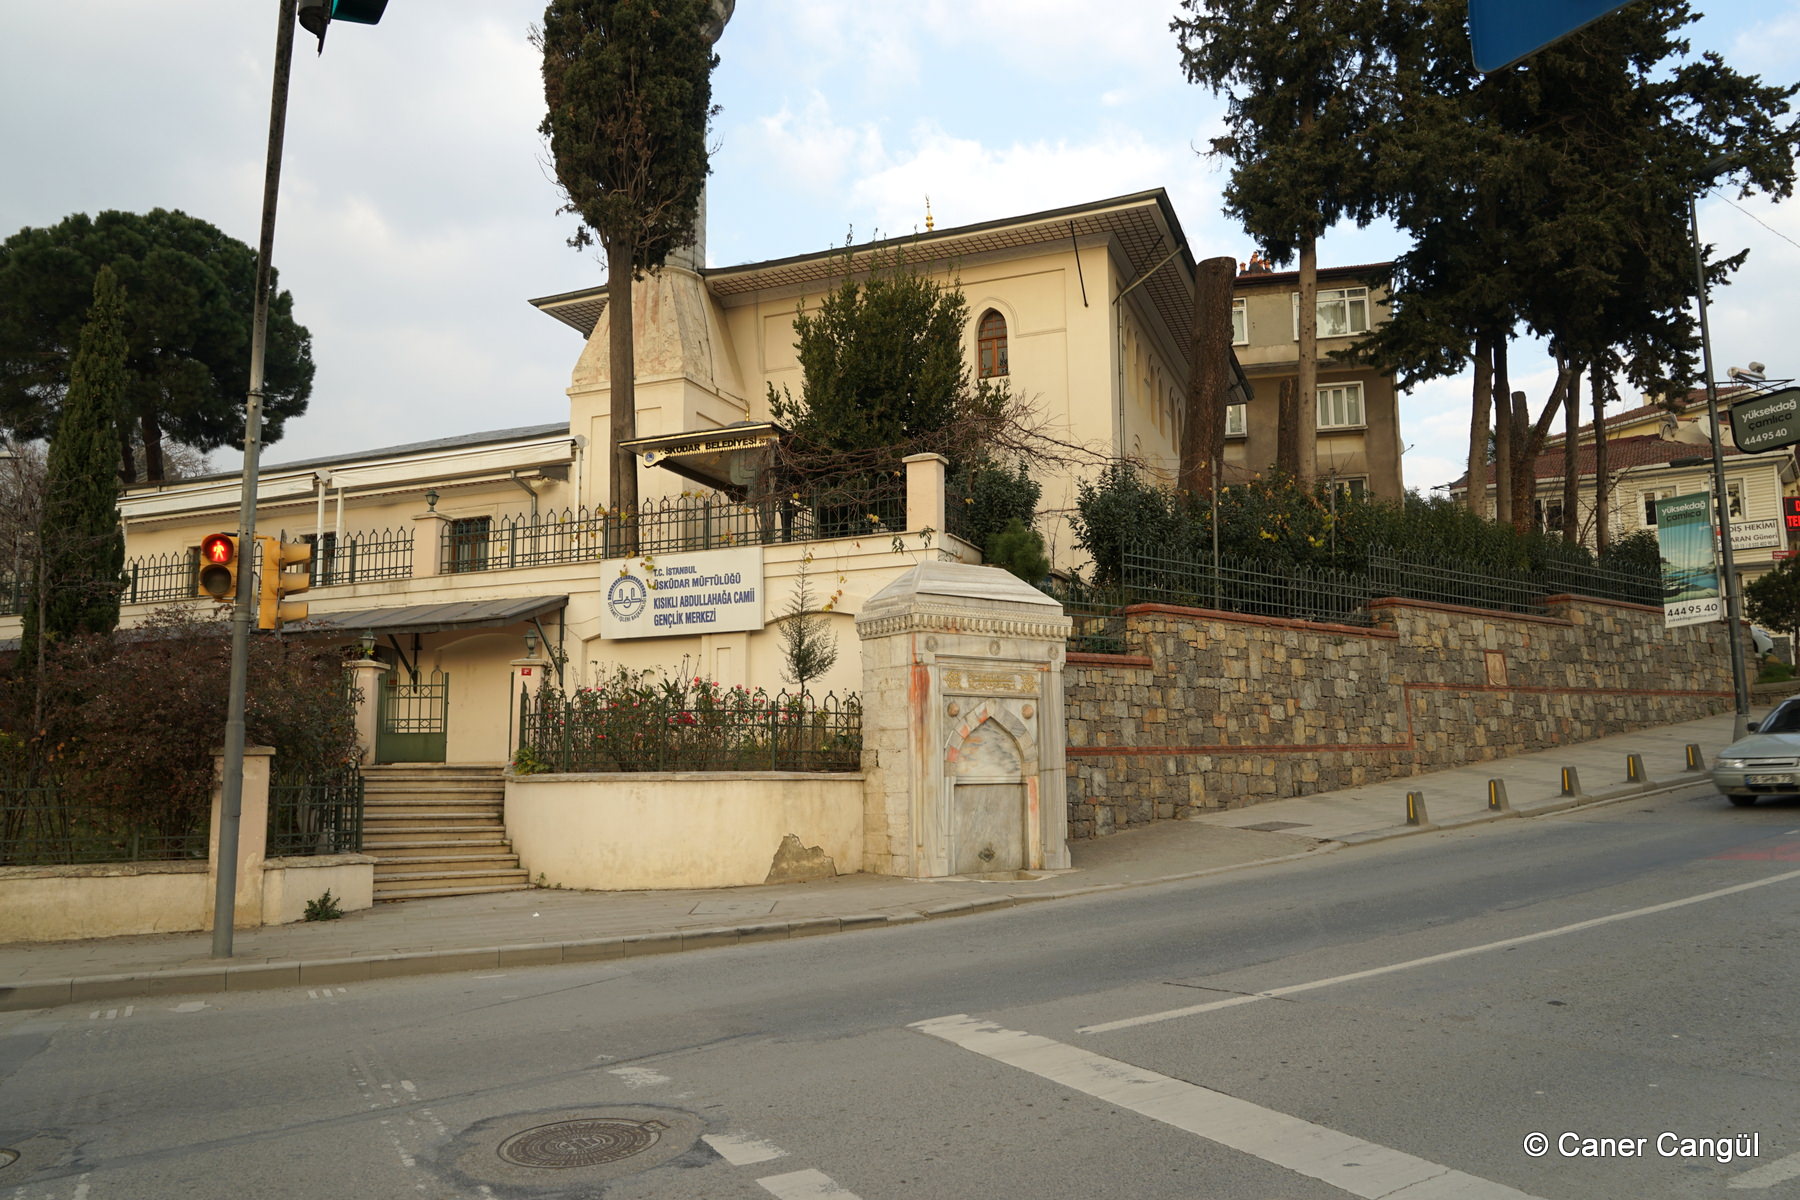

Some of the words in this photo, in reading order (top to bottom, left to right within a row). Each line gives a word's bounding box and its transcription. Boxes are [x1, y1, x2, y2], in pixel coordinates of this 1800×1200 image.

[1741, 399, 1797, 423] yüksekdağ
[1748, 412, 1793, 431] çamlıca
[1775, 428, 1788, 437] 40
[705, 434, 757, 450] BELEDİYESİ
[1661, 500, 1706, 516] yüksekdağ
[1745, 520, 1776, 531] HEKİMİ
[1753, 532, 1778, 541] Güneri
[666, 565, 697, 576] İSTANBUL
[653, 577, 690, 590] ÜSKÜDAR
[692, 572, 741, 588] MÜFTÜLÜĞÜ
[653, 594, 679, 610] KISIKLI
[679, 589, 733, 608] ABDULLAHAĞA
[734, 587, 755, 603] CAMİİ
[653, 611, 684, 629] GENÇLİK
[685, 607, 717, 624] MERKEZİ
[1667, 607, 1686, 617] 444
[1688, 605, 1702, 614] 95
[1704, 603, 1718, 612] 40
